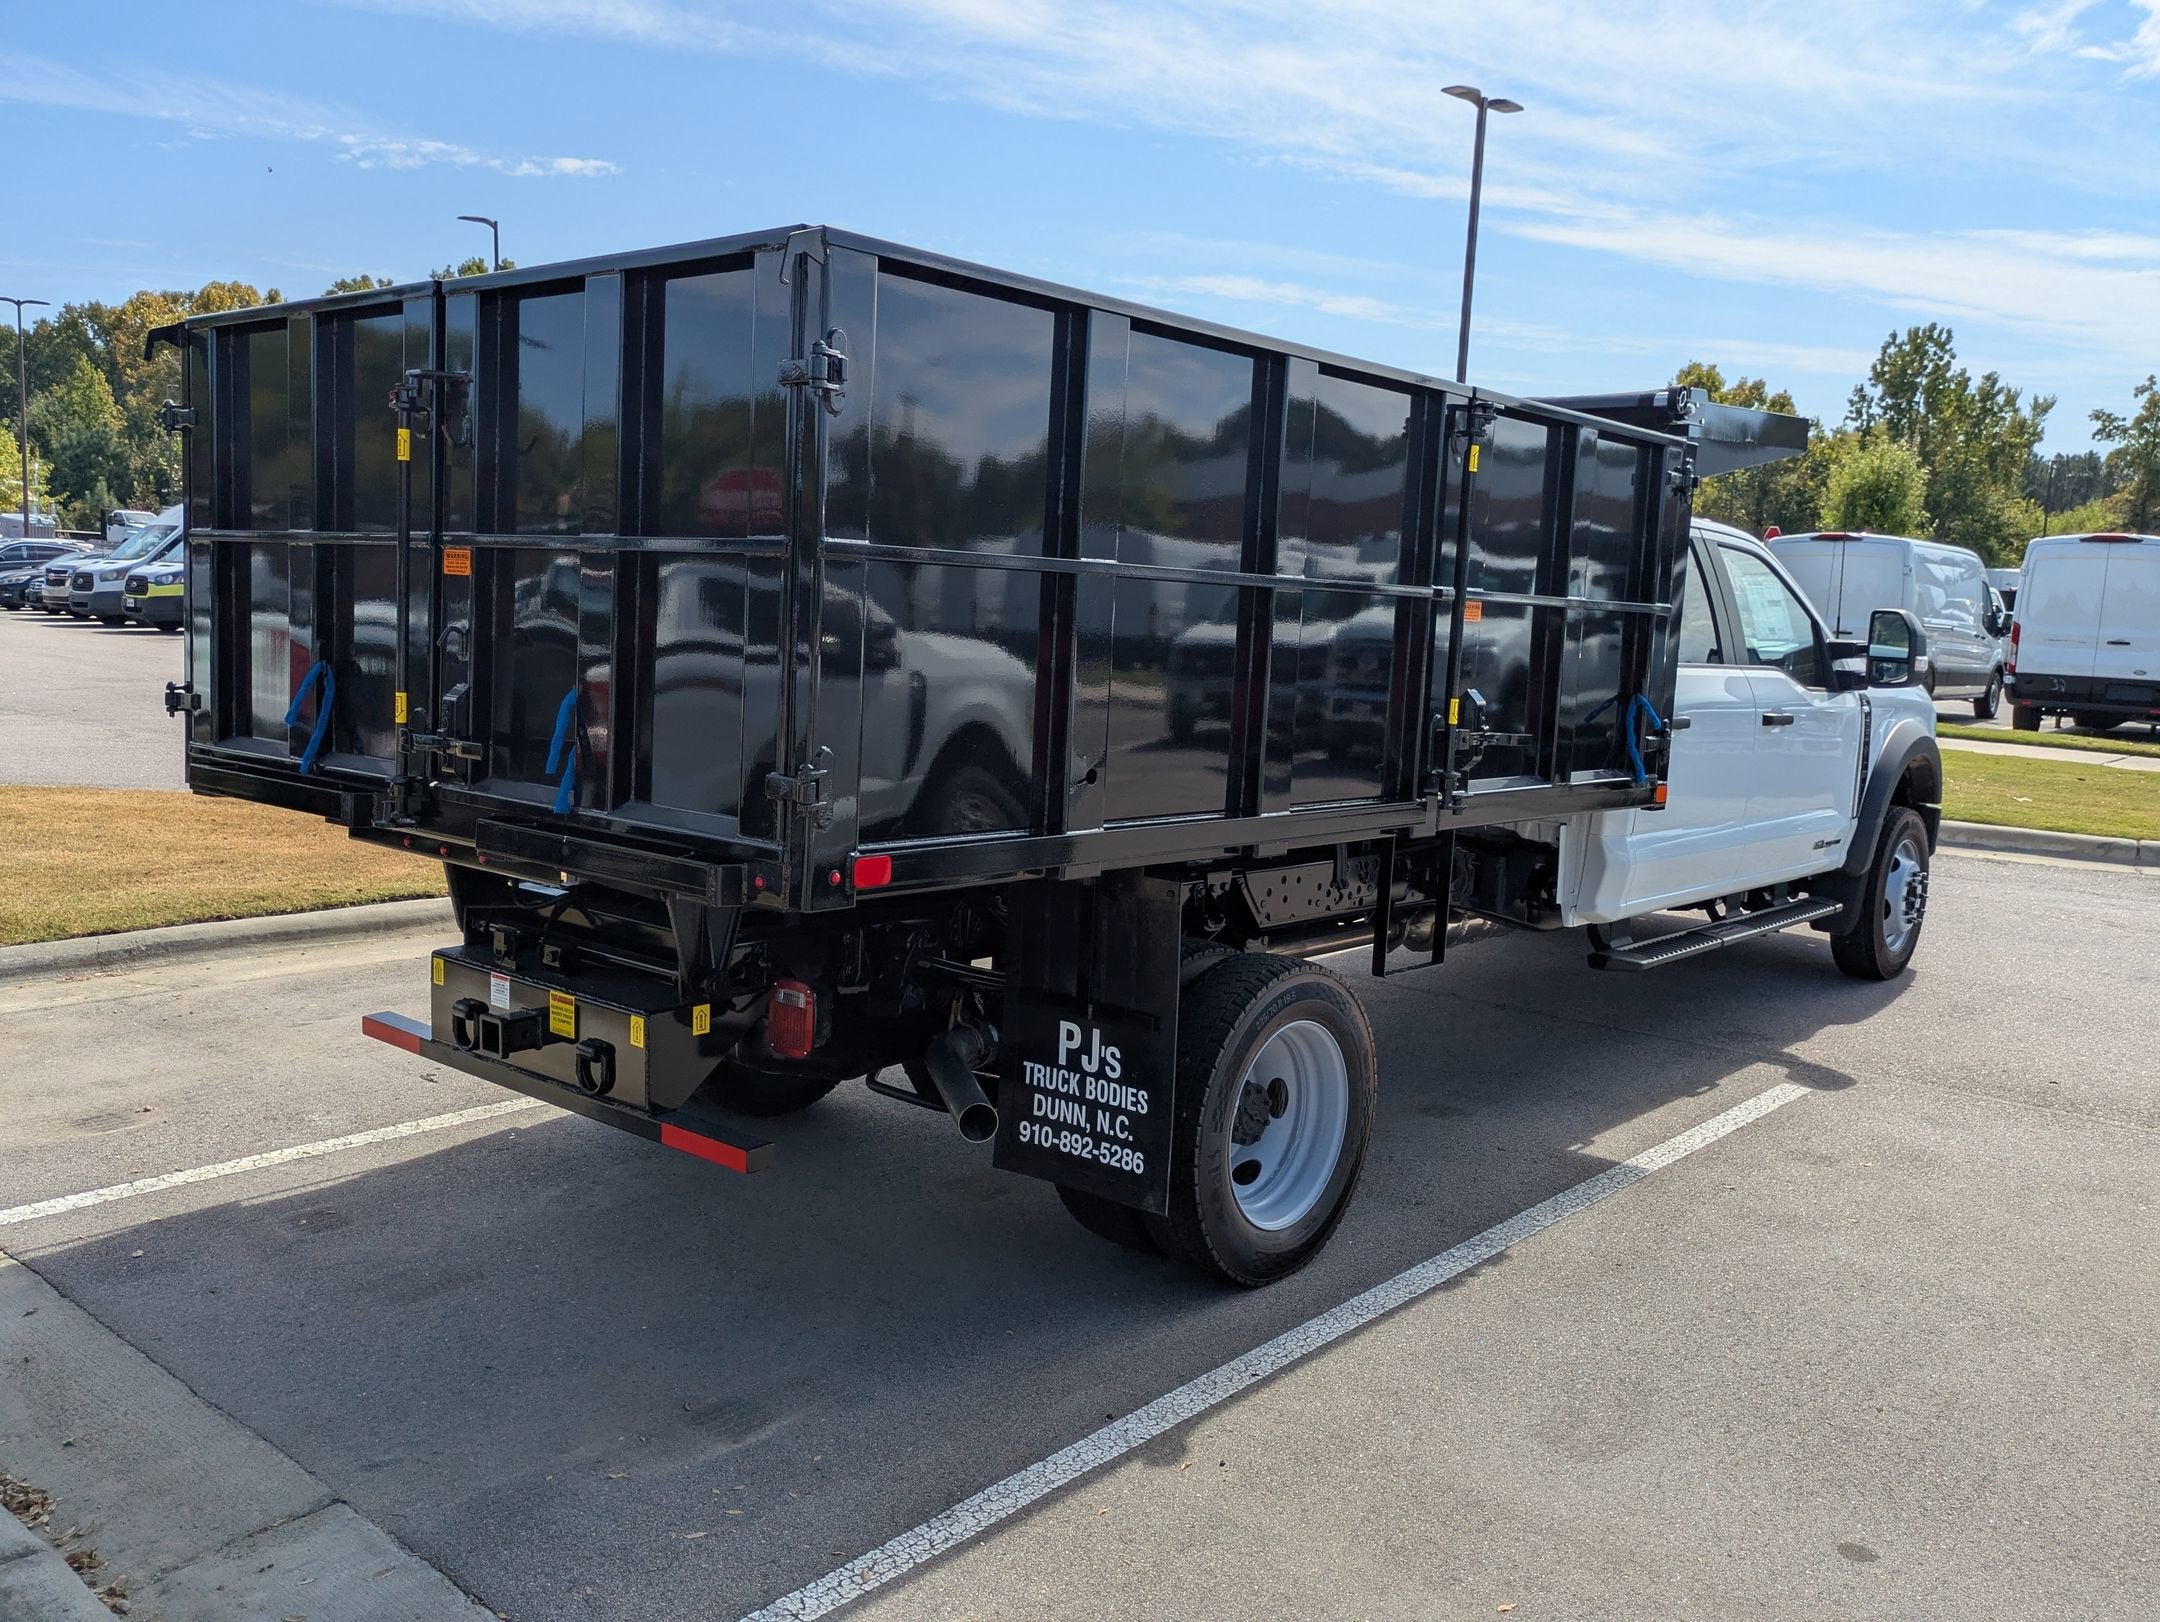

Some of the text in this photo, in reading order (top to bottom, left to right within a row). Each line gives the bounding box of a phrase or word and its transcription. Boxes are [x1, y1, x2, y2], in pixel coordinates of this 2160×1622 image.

[1058, 1020, 1121, 1079] PJ'S
[1023, 1061, 1149, 1114] TRUCK BODIES
[1033, 1093, 1134, 1141] DUNN, N.C.
[1019, 1120, 1145, 1174] 910-892-5286
